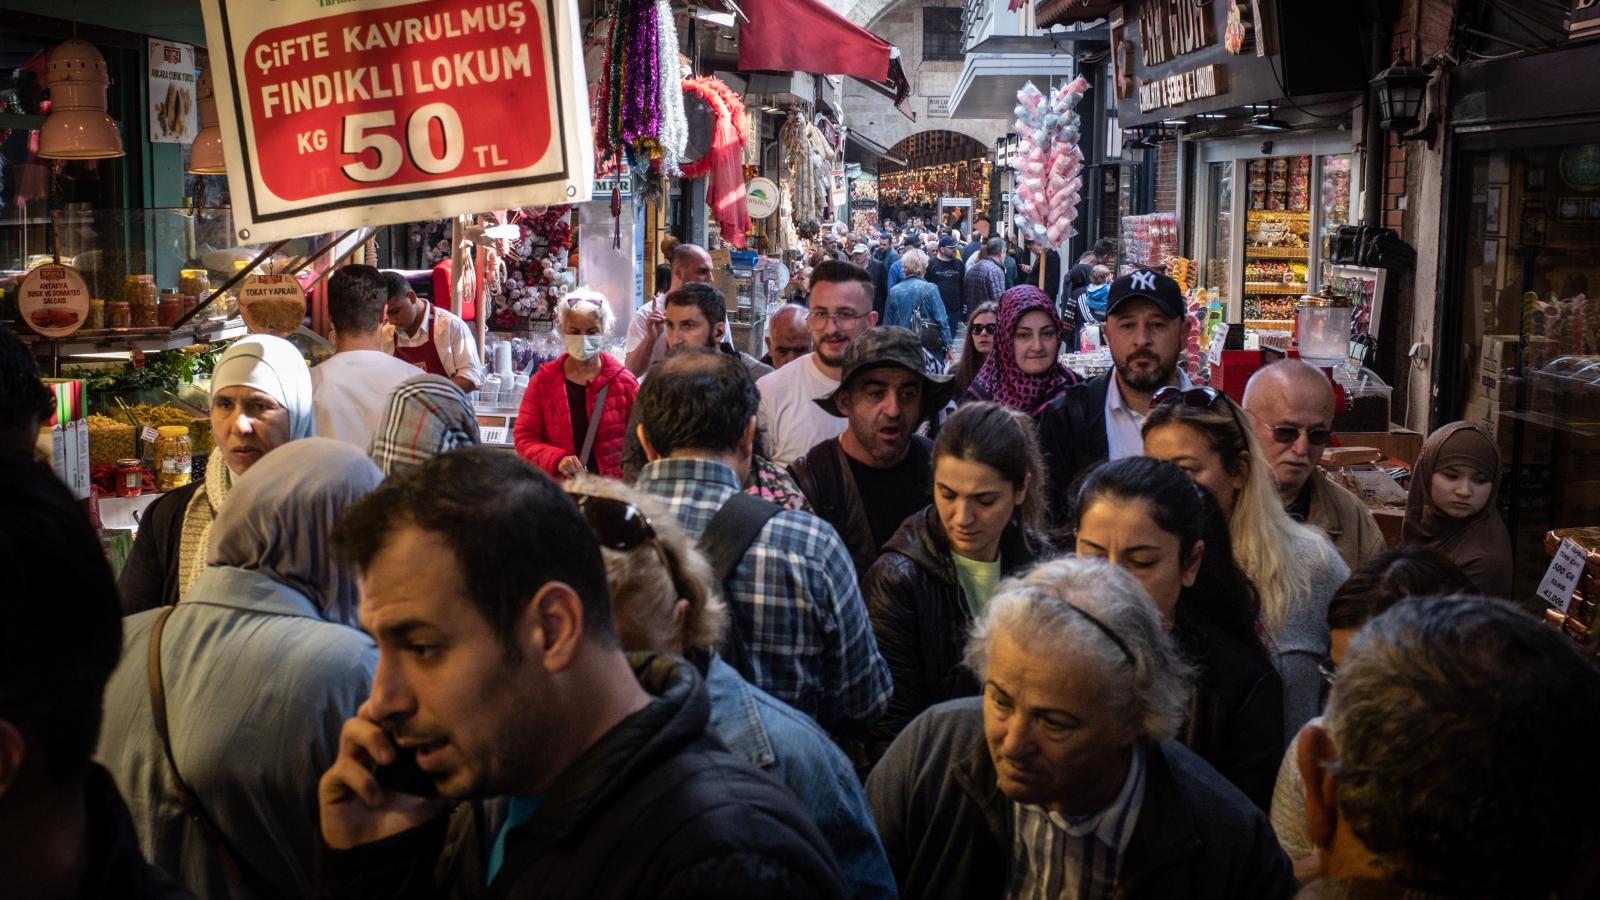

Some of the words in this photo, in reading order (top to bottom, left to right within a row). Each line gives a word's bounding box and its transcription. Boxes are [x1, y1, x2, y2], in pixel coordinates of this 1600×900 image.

[254, 32, 329, 74] ÇİFTE
[342, 1, 526, 52] KAVRULMUŞ
[261, 63, 404, 118] FINDIKLI
[413, 44, 531, 94] LOKUM
[297, 129, 328, 154] KG
[341, 102, 465, 182] 50
[473, 144, 508, 168] TL
[246, 288, 268, 296] TOKAT
[1130, 271, 1156, 290] NY
[1553, 563, 1566, 574] 500
